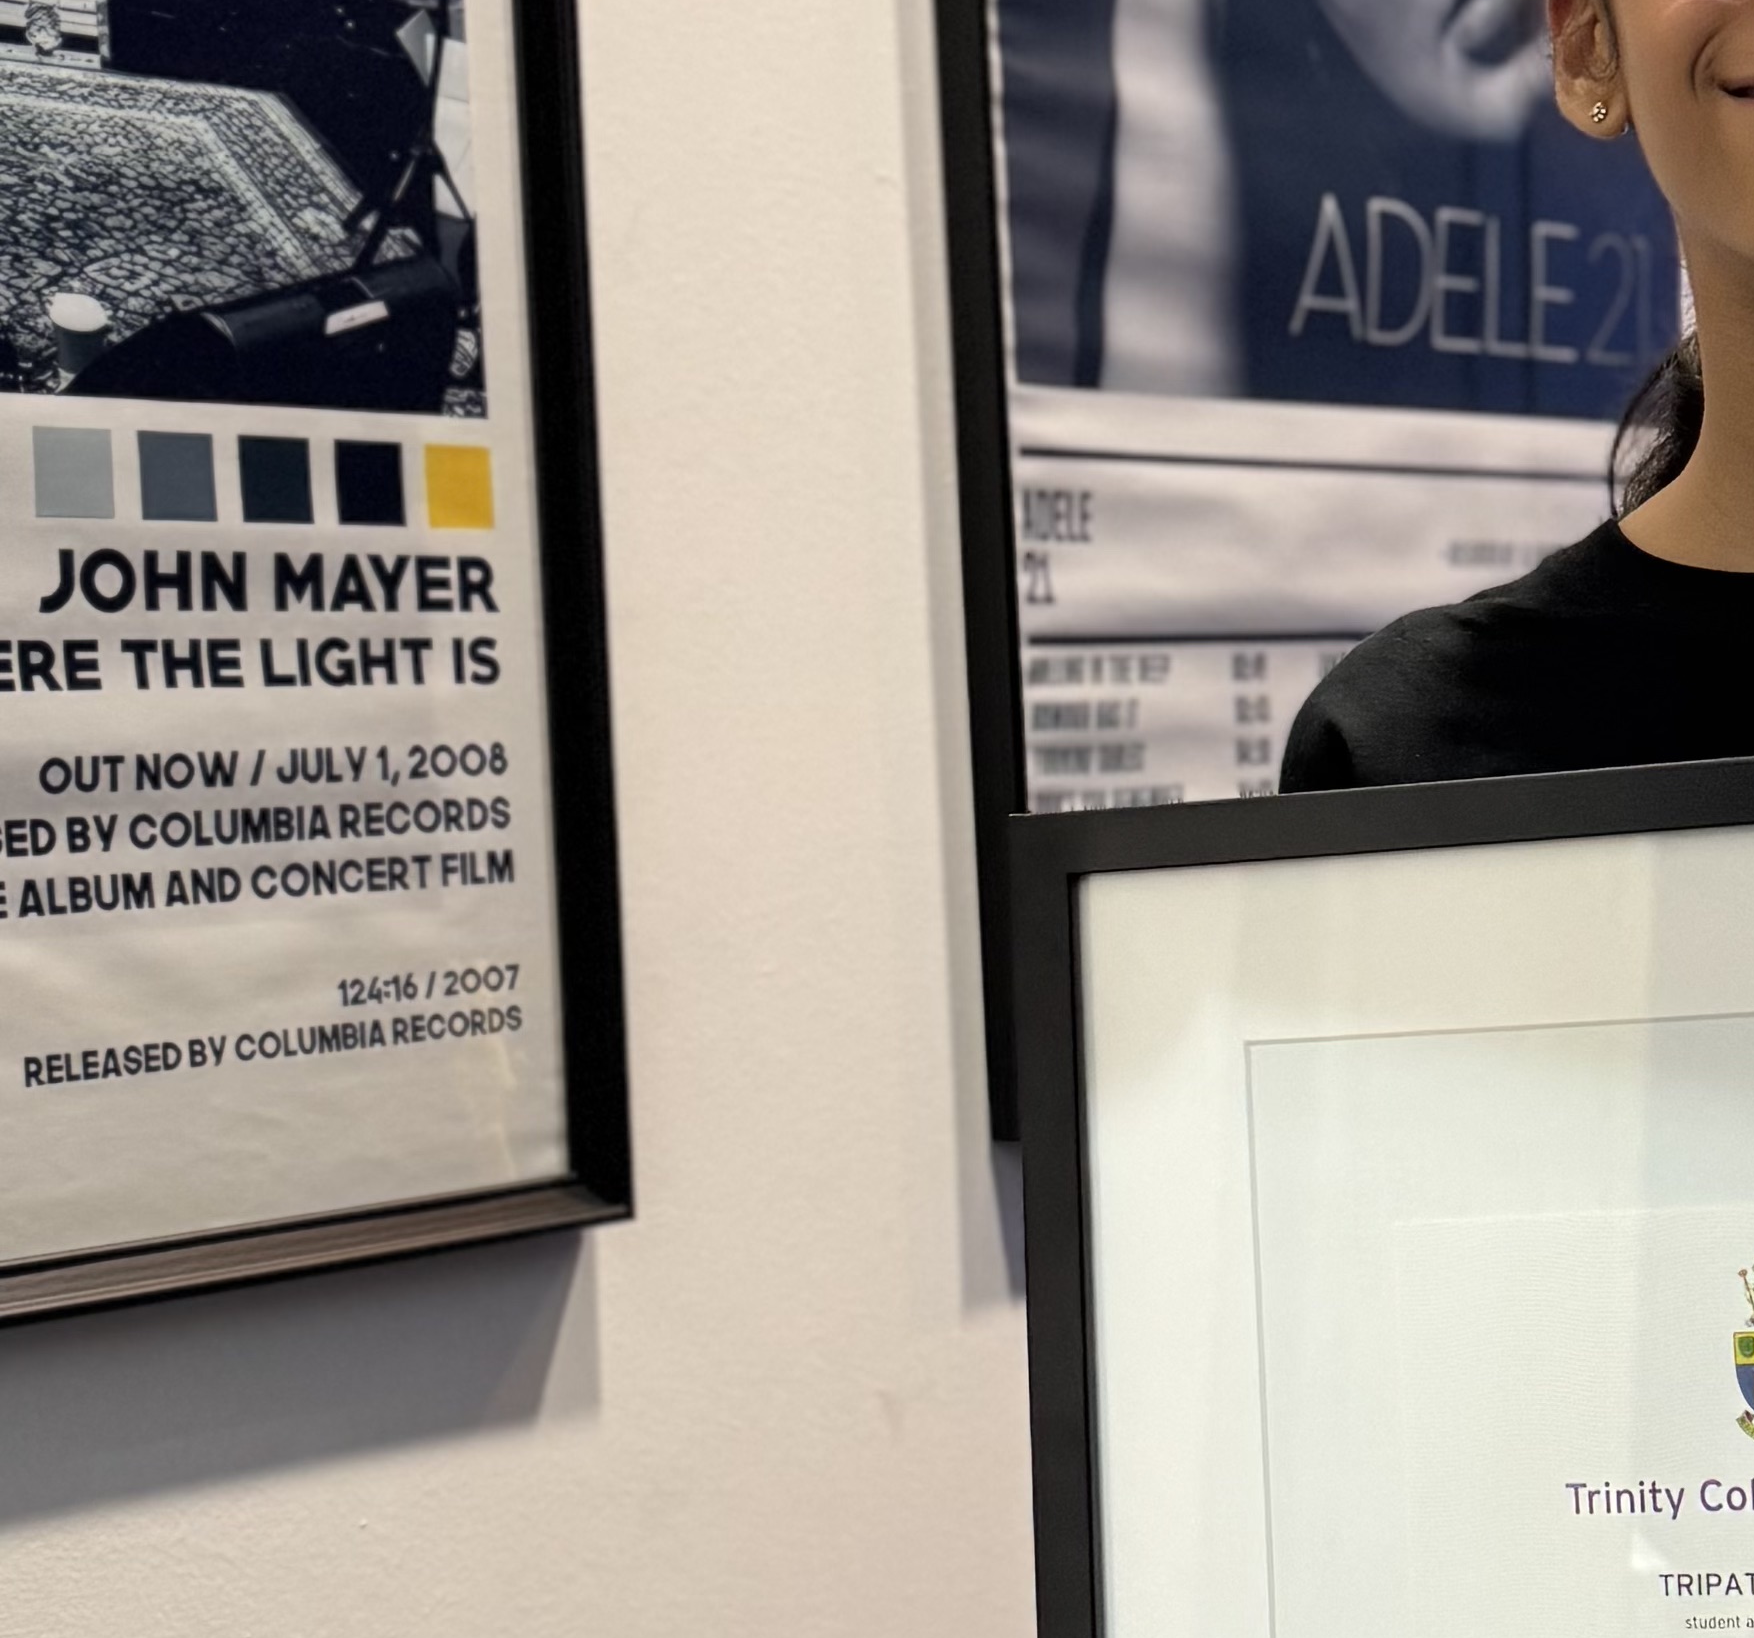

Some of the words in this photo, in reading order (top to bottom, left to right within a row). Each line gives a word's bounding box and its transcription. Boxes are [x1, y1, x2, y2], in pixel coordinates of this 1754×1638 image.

[1288, 192, 1580, 363] ADELE
[39, 548, 248, 613] JOHN
[274, 552, 500, 613] MAYER
[121, 638, 245, 691] THE
[260, 637, 433, 687] LIGHT
[452, 636, 501, 685] IS
[39, 754, 125, 795] OUT
[135, 750, 239, 791] NOW
[249, 749, 266, 786] /
[276, 746, 367, 784] JULY
[376, 745, 401, 787] 1,
[407, 742, 508, 780] 2008
[0, 818, 57, 857] ED
[66, 814, 118, 854] BY
[129, 805, 331, 850] COLUMBIA
[339, 796, 511, 839] RECORDS
[18, 872, 156, 918] ALBUM
[165, 867, 242, 907] AND
[251, 854, 432, 899] CONCERT
[441, 849, 515, 887] FILM
[337, 972, 418, 1007] 124:16
[425, 971, 436, 999] /
[443, 963, 520, 996] 2007
[24, 1041, 182, 1088] RELEASED
[188, 1035, 227, 1067] BY
[235, 1019, 386, 1061] COLUMBIA
[392, 1005, 522, 1045] RECORDS
[1565, 1480, 1685, 1520] Trinity
[1685, 1615, 1740, 1629] student
